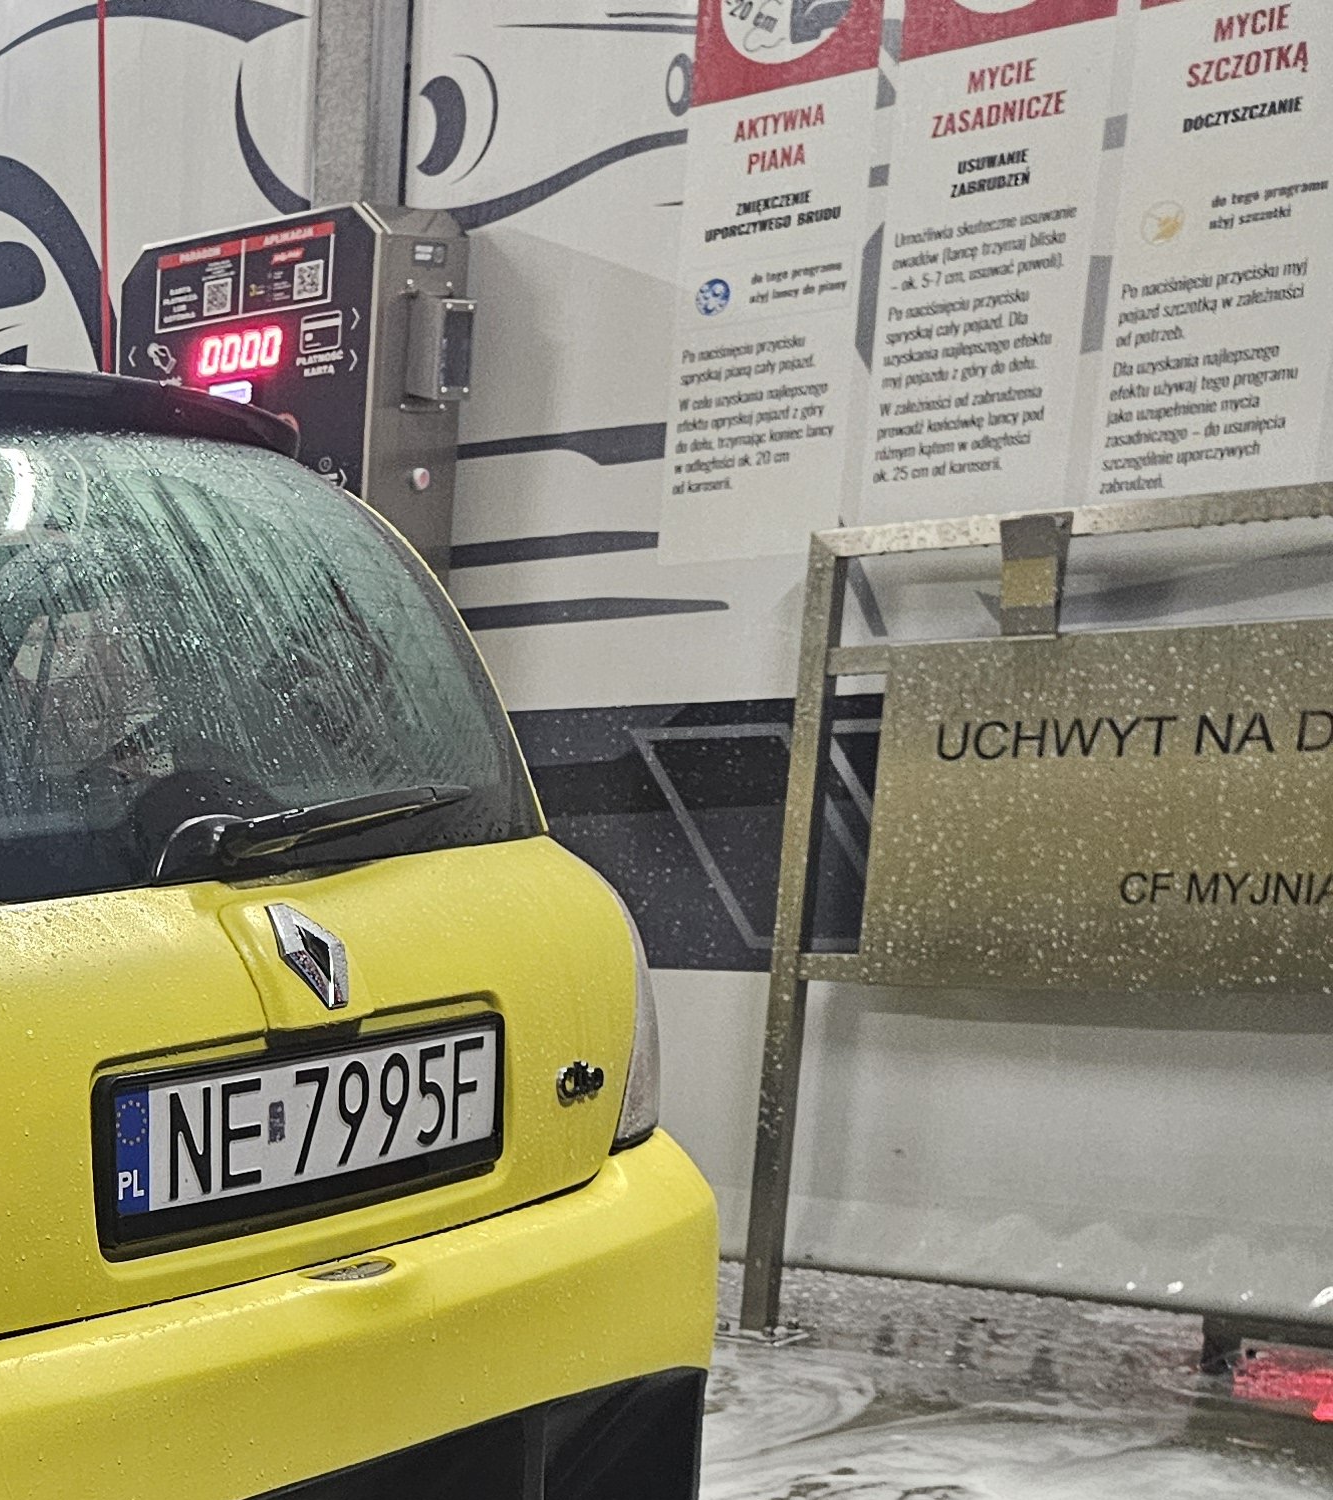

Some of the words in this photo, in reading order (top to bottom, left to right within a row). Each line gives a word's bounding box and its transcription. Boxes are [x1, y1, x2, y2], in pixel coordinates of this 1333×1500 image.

[1214, 2, 1292, 43] MYCIE
[967, 58, 1038, 94] MYCIE
[1186, 41, 1309, 88] SZCZOTKĄ
[734, 104, 825, 143] AKTYWNA
[931, 90, 1067, 139] ZASADNICZE
[1183, 96, 1304, 133] DOCZYSZCZANIE
[748, 143, 805, 174] PIANA
[958, 148, 1029, 175] USUWANIE
[950, 166, 1031, 198] ZABRUDZEŃ
[1211, 194, 1227, 208] do
[1231, 190, 1260, 205] tego
[1264, 180, 1329, 202] programu
[736, 189, 812, 216] ZMIĘKCZENIE
[1209, 214, 1235, 230] użyj
[1238, 204, 1292, 226] szczotki
[705, 215, 792, 242] UPORCZYWEGO
[797, 206, 841, 226] BRUDU
[1121, 283, 1138, 300] Po
[1216, 263, 1280, 290] przycisku
[1283, 256, 1309, 277] myj
[888, 306, 903, 322] Po
[1118, 303, 1160, 327] pojazd
[1162, 296, 1218, 318] szczotką
[1221, 297, 1233, 309] w
[198, 326, 283, 377] 0000
[1115, 332, 1131, 348] od
[960, 363, 988, 382] góry
[991, 360, 1006, 374] do
[1113, 361, 1134, 378] Dla
[1136, 355, 1199, 376] uzyskania
[1202, 345, 1280, 368] najlepszego
[954, 392, 969, 408] od
[1110, 384, 1150, 401] efektu
[1153, 376, 1198, 397] używaj
[1201, 375, 1230, 392] tego
[1233, 367, 1299, 390] programu
[1106, 409, 1133, 428] jako
[1220, 394, 1261, 412] mycia
[1105, 427, 1189, 449] zasadniczego
[1204, 421, 1221, 438] do
[1223, 414, 1286, 435] usunięcia
[755, 450, 771, 466] 20
[1176, 439, 1261, 466] uporczywych
[892, 466, 909, 481] 25
[911, 467, 929, 479] cm
[932, 461, 946, 476] od
[936, 716, 1178, 762] UCHWYT
[1195, 712, 1275, 756] NA
[1120, 872, 1175, 906] CF
[169, 1077, 262, 1201] NE
[294, 1036, 484, 1176] 7995F
[118, 1169, 145, 1201] PL
